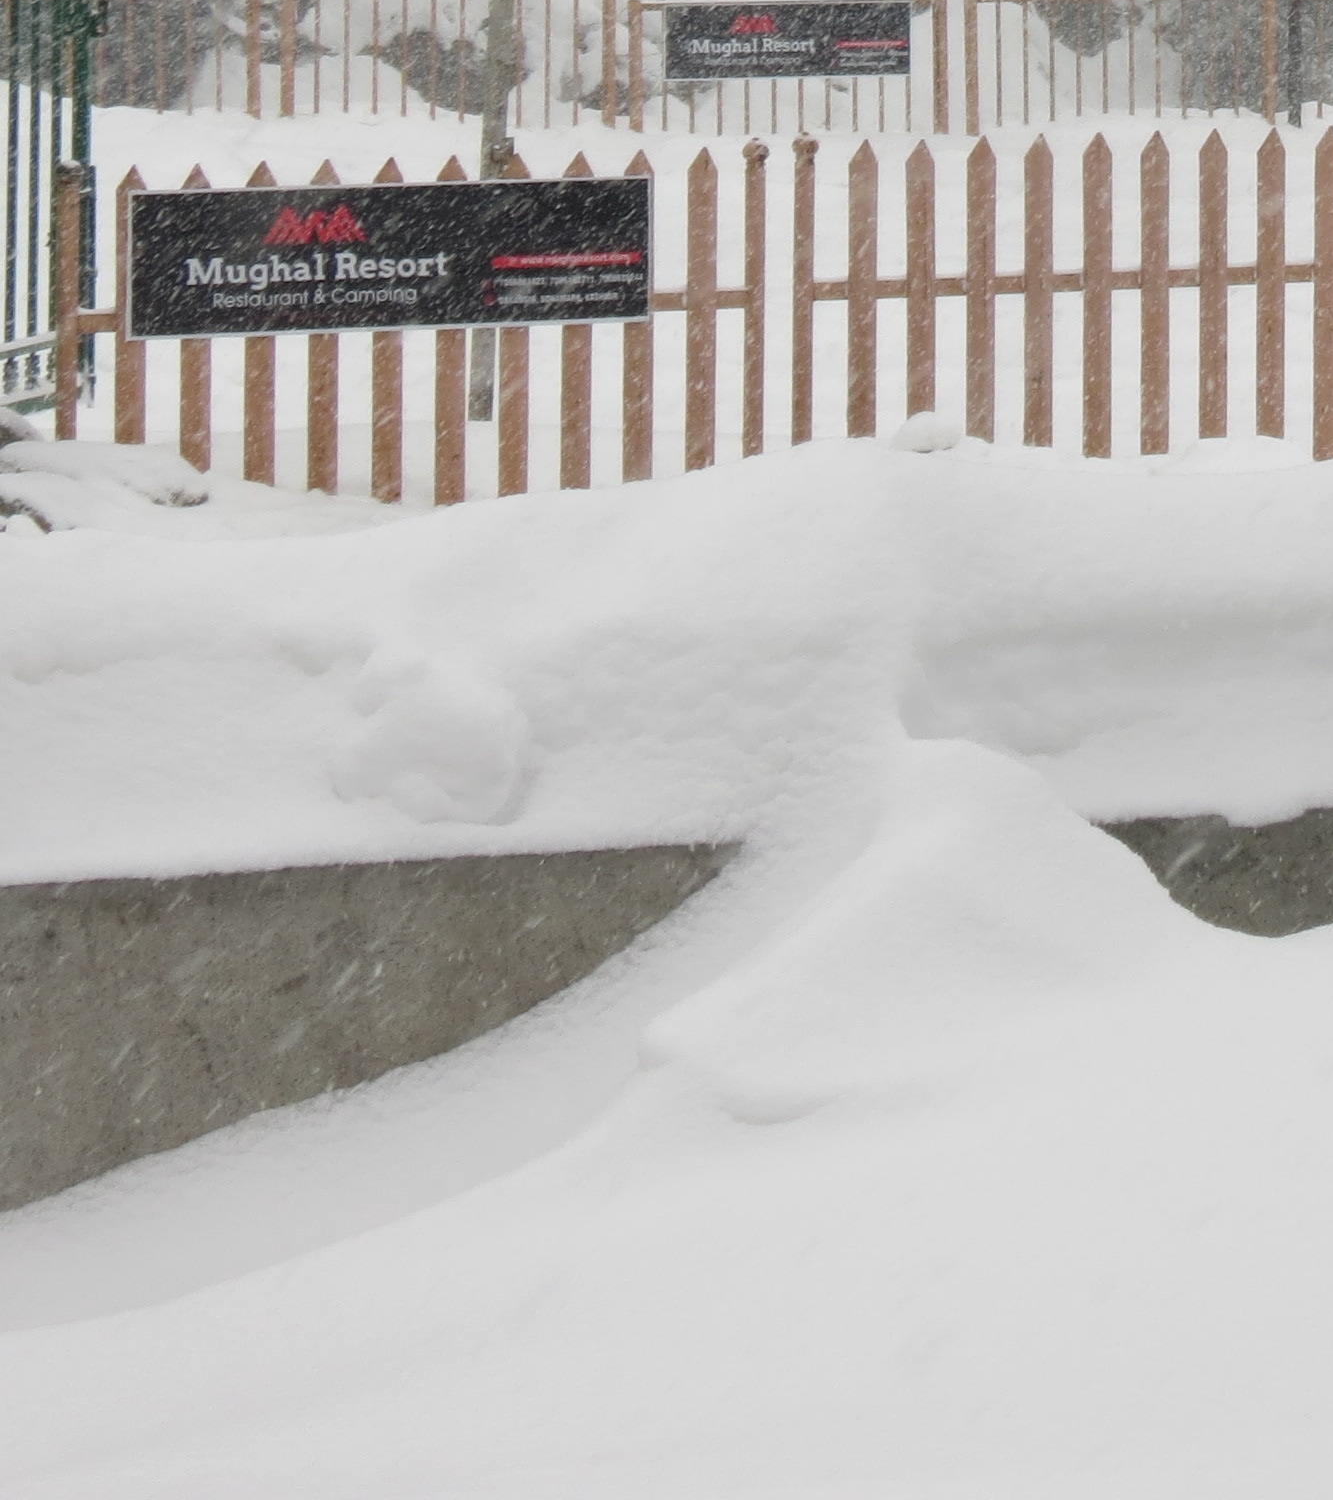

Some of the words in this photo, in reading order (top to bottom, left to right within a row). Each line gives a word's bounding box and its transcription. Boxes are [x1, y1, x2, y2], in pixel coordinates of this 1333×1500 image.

[689, 38, 759, 58] Mughal
[761, 38, 817, 54] Resort
[184, 253, 327, 291] Mughal
[334, 250, 449, 280] Resort
[212, 289, 309, 309] Restaurant
[314, 286, 326, 305] &
[330, 286, 418, 305] Camping
